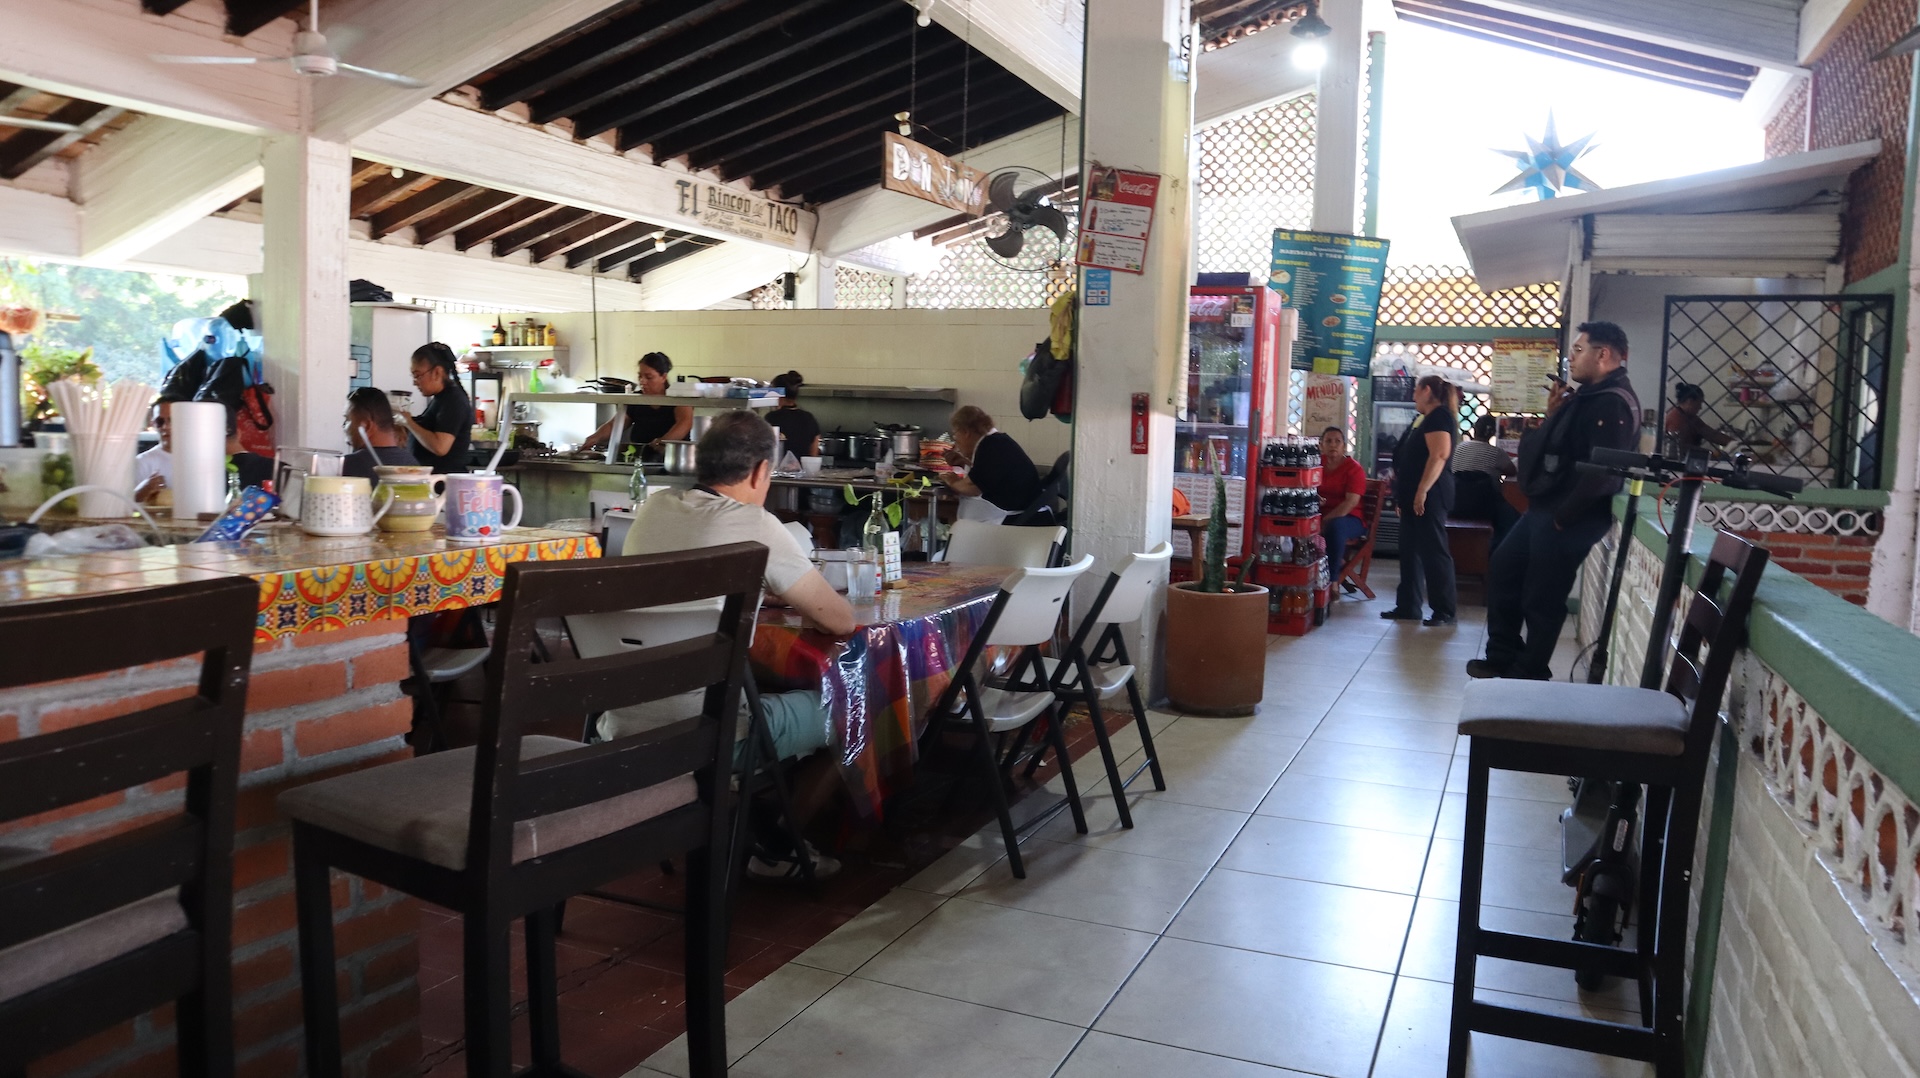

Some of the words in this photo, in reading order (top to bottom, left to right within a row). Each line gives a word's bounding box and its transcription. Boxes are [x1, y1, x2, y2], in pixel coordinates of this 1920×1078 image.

[1119, 181, 1155, 196] Coca-Cola
[767, 202, 798, 235] TACO
[1280, 232, 1290, 240] EL
[1334, 237, 1351, 246] DEL
[1355, 239, 1381, 248] TACO
[1307, 383, 1344, 400] MENUDO
